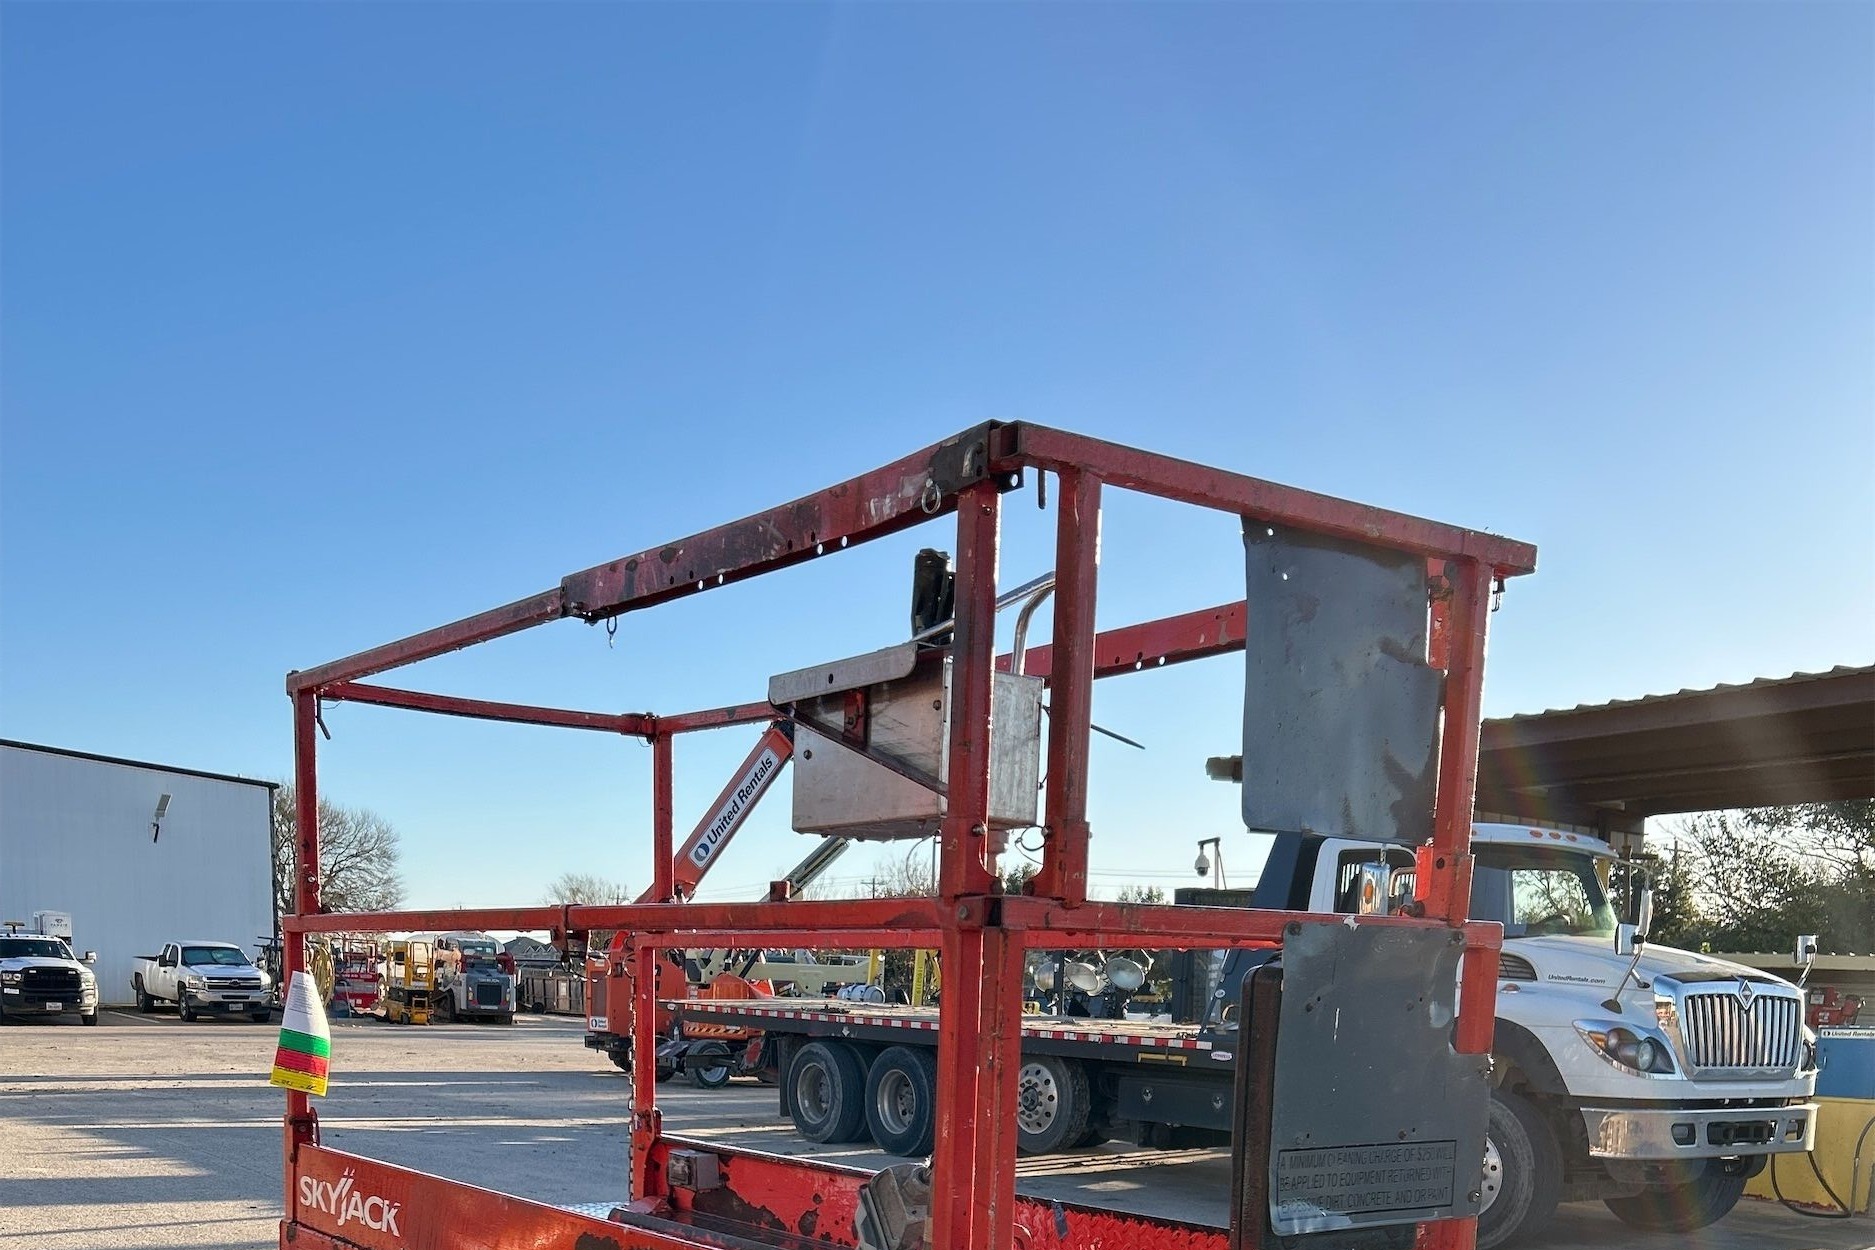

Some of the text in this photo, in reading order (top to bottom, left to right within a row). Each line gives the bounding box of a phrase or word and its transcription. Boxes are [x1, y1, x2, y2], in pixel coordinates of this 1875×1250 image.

[707, 757, 773, 845] United Rentals
[300, 1167, 402, 1238] SKYJACK
